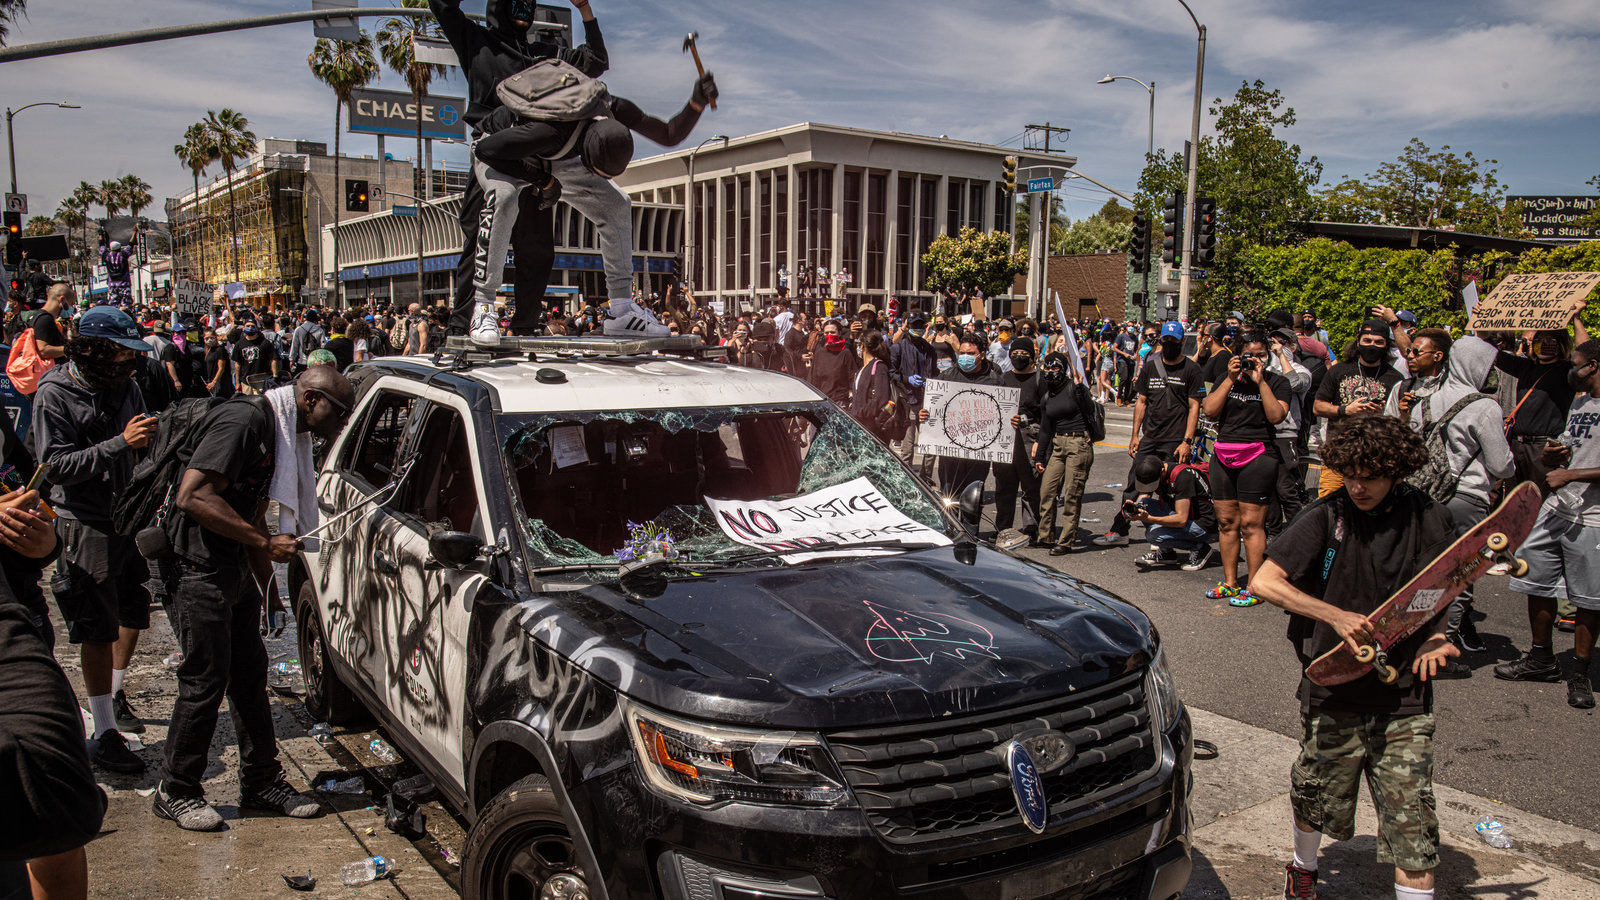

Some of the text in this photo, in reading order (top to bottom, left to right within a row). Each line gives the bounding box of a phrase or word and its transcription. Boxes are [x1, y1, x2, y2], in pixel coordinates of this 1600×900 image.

[356, 99, 435, 122] CHASE
[1030, 181, 1051, 190] Fairfax
[474, 243, 487, 279] AIR
[178, 280, 214, 294] LATINAS
[1522, 282, 1557, 291] LAPD
[178, 293, 211, 306] BLACK
[1502, 291, 1554, 299] HISTORY
[1555, 290, 1576, 299] OF
[183, 303, 210, 315] LIVES
[1495, 300, 1563, 308] MISCONDUCT.
[1540, 309, 1571, 319] WITH
[1472, 319, 1563, 329] CRIMINAL RECORDS.
[926, 381, 949, 393] BLM!
[720, 492, 888, 539] NO JUSTICE
[405, 671, 429, 705] POLICE
[1017, 763, 1042, 811] Ford
